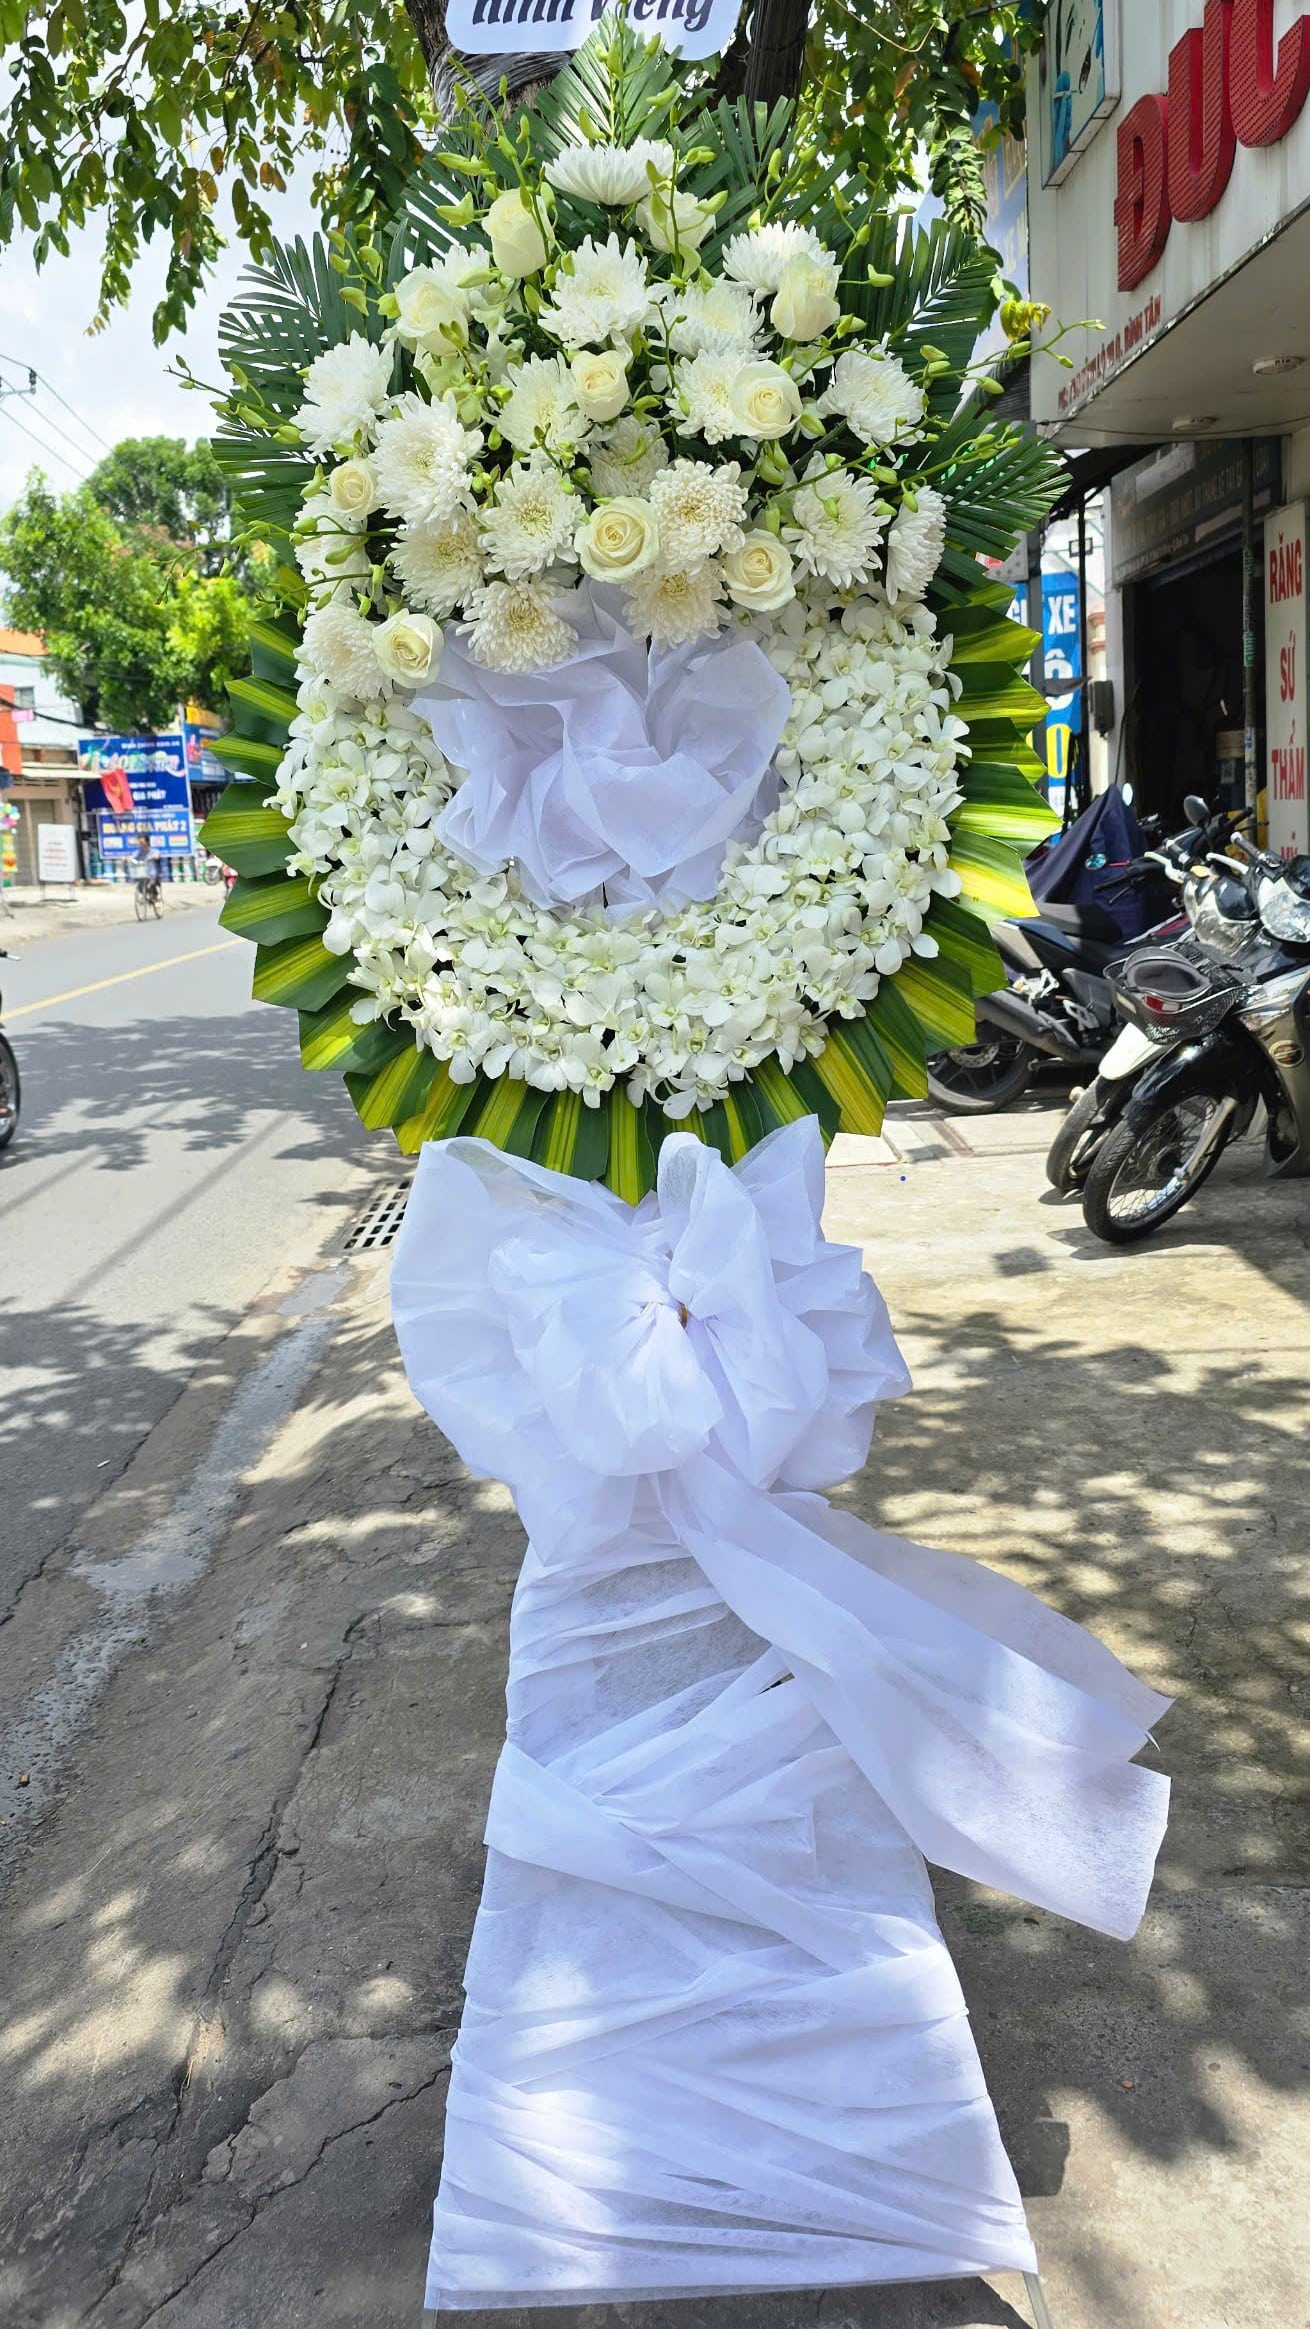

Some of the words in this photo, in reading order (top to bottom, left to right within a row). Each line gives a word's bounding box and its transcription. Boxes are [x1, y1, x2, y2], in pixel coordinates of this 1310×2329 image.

[1269, 531, 1303, 603] RĂNG
[1047, 594, 1077, 635] XE
[1279, 629, 1297, 702] SỨ
